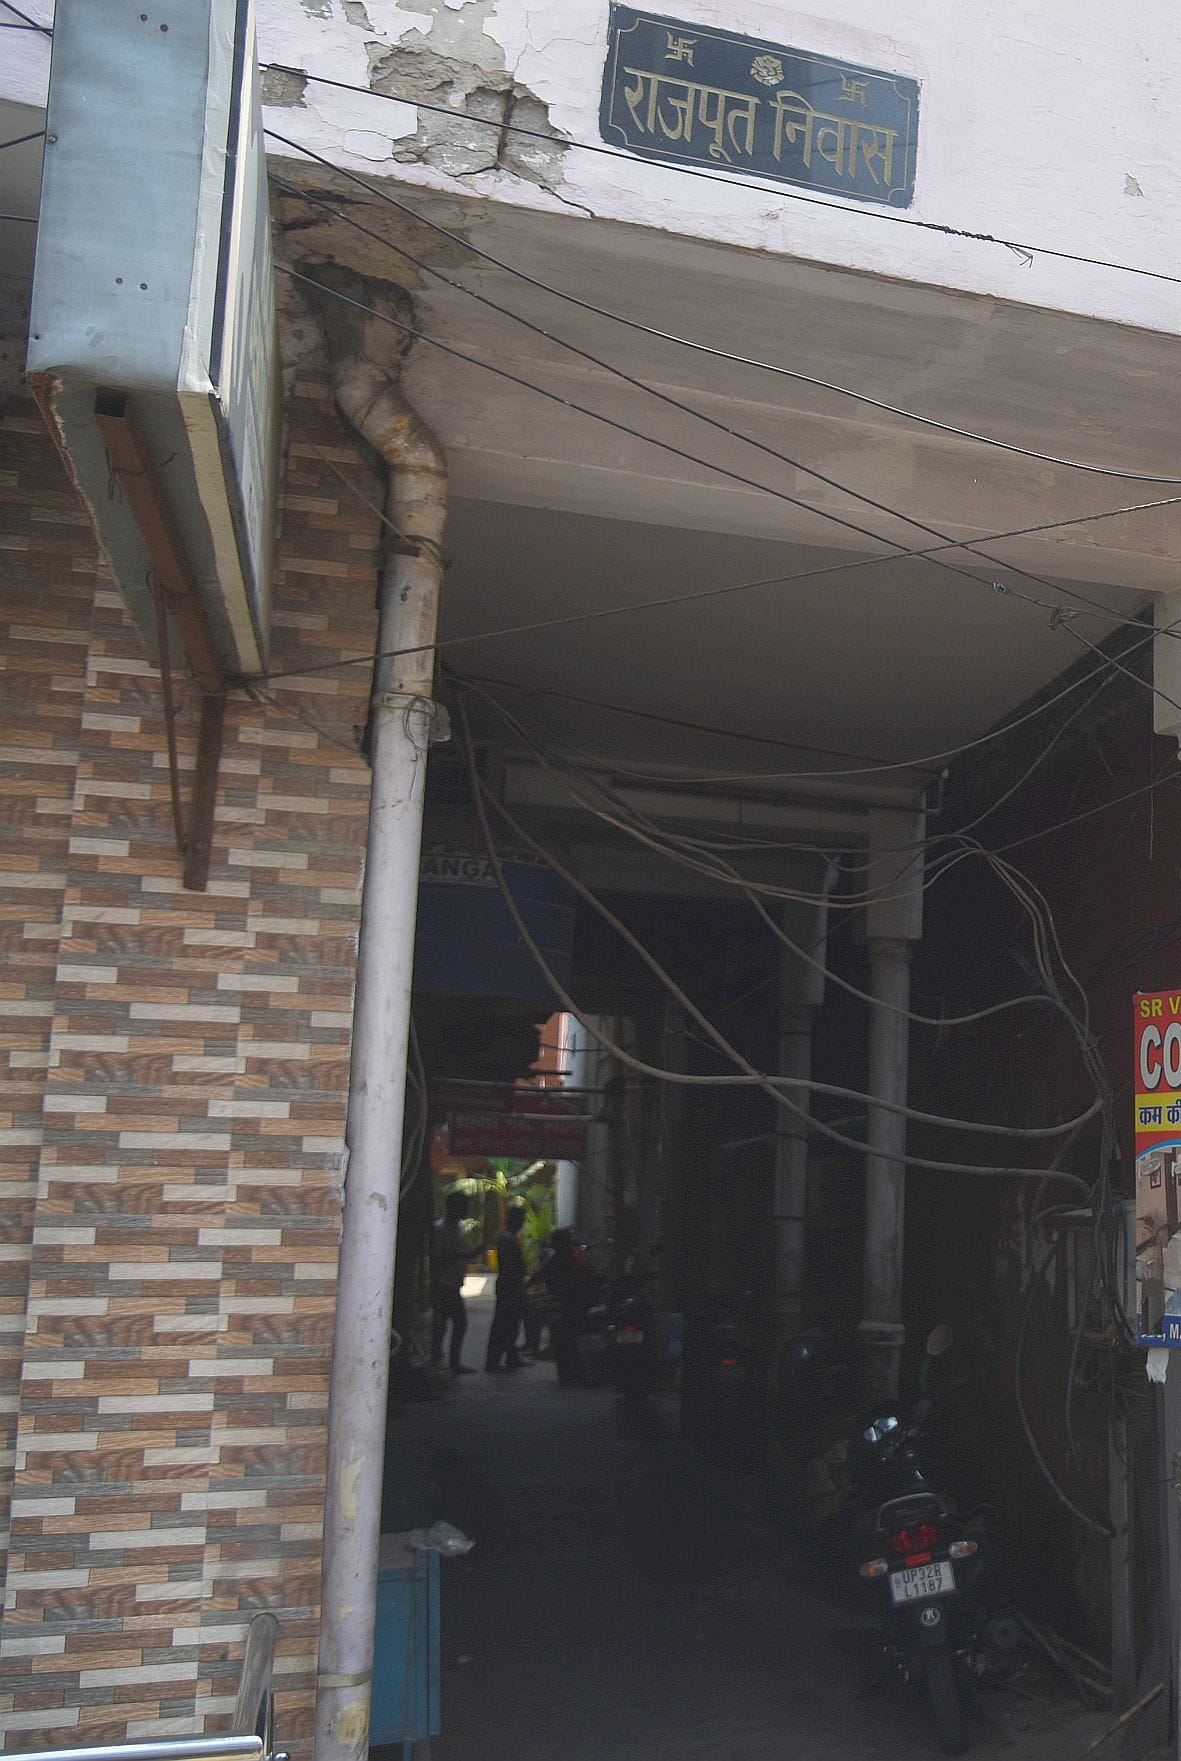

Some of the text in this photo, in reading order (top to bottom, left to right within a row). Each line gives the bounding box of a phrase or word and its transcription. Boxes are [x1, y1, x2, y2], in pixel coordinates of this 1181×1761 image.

[624, 66, 898, 187] राजपूत निवास
[1140, 999, 1163, 1019] SR
[1139, 1105, 1162, 1125] कम
